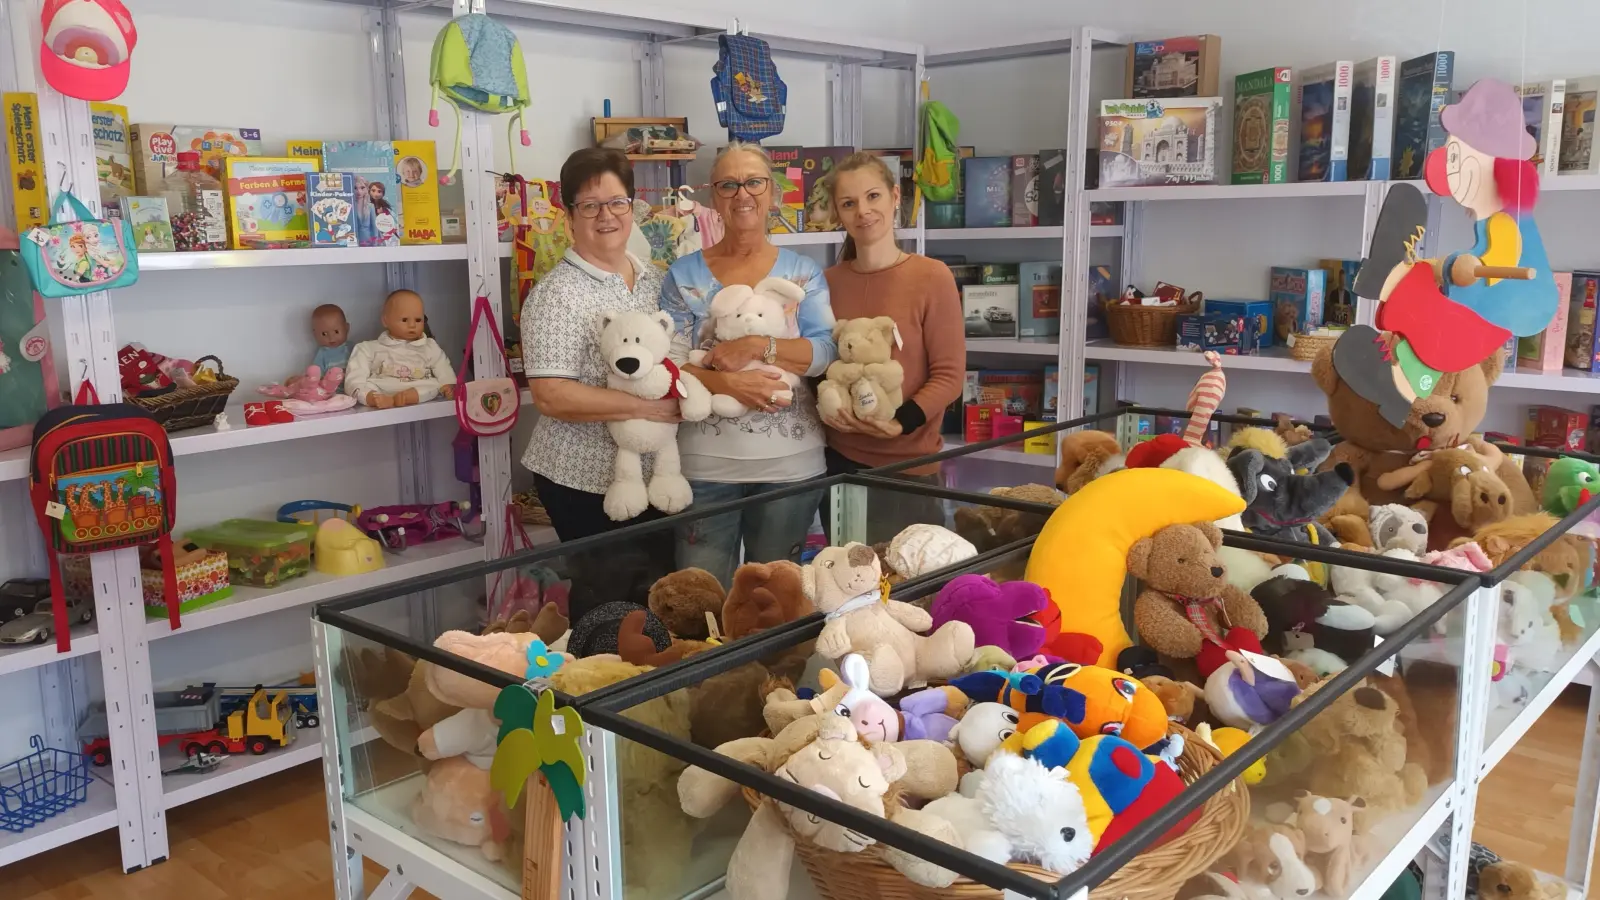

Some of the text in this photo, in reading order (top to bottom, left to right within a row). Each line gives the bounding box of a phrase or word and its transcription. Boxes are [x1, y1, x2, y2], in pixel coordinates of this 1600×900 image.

[1381, 60, 1390, 79] 1000
[1339, 65, 1349, 87] 1000
[92, 115, 113, 126] erster
[24, 106, 36, 164] Mein erster
[152, 137, 173, 147] Play
[154, 145, 173, 154] tive
[771, 148, 798, 160] land
[240, 182, 270, 190] Farben
[408, 229, 436, 240] HABA
